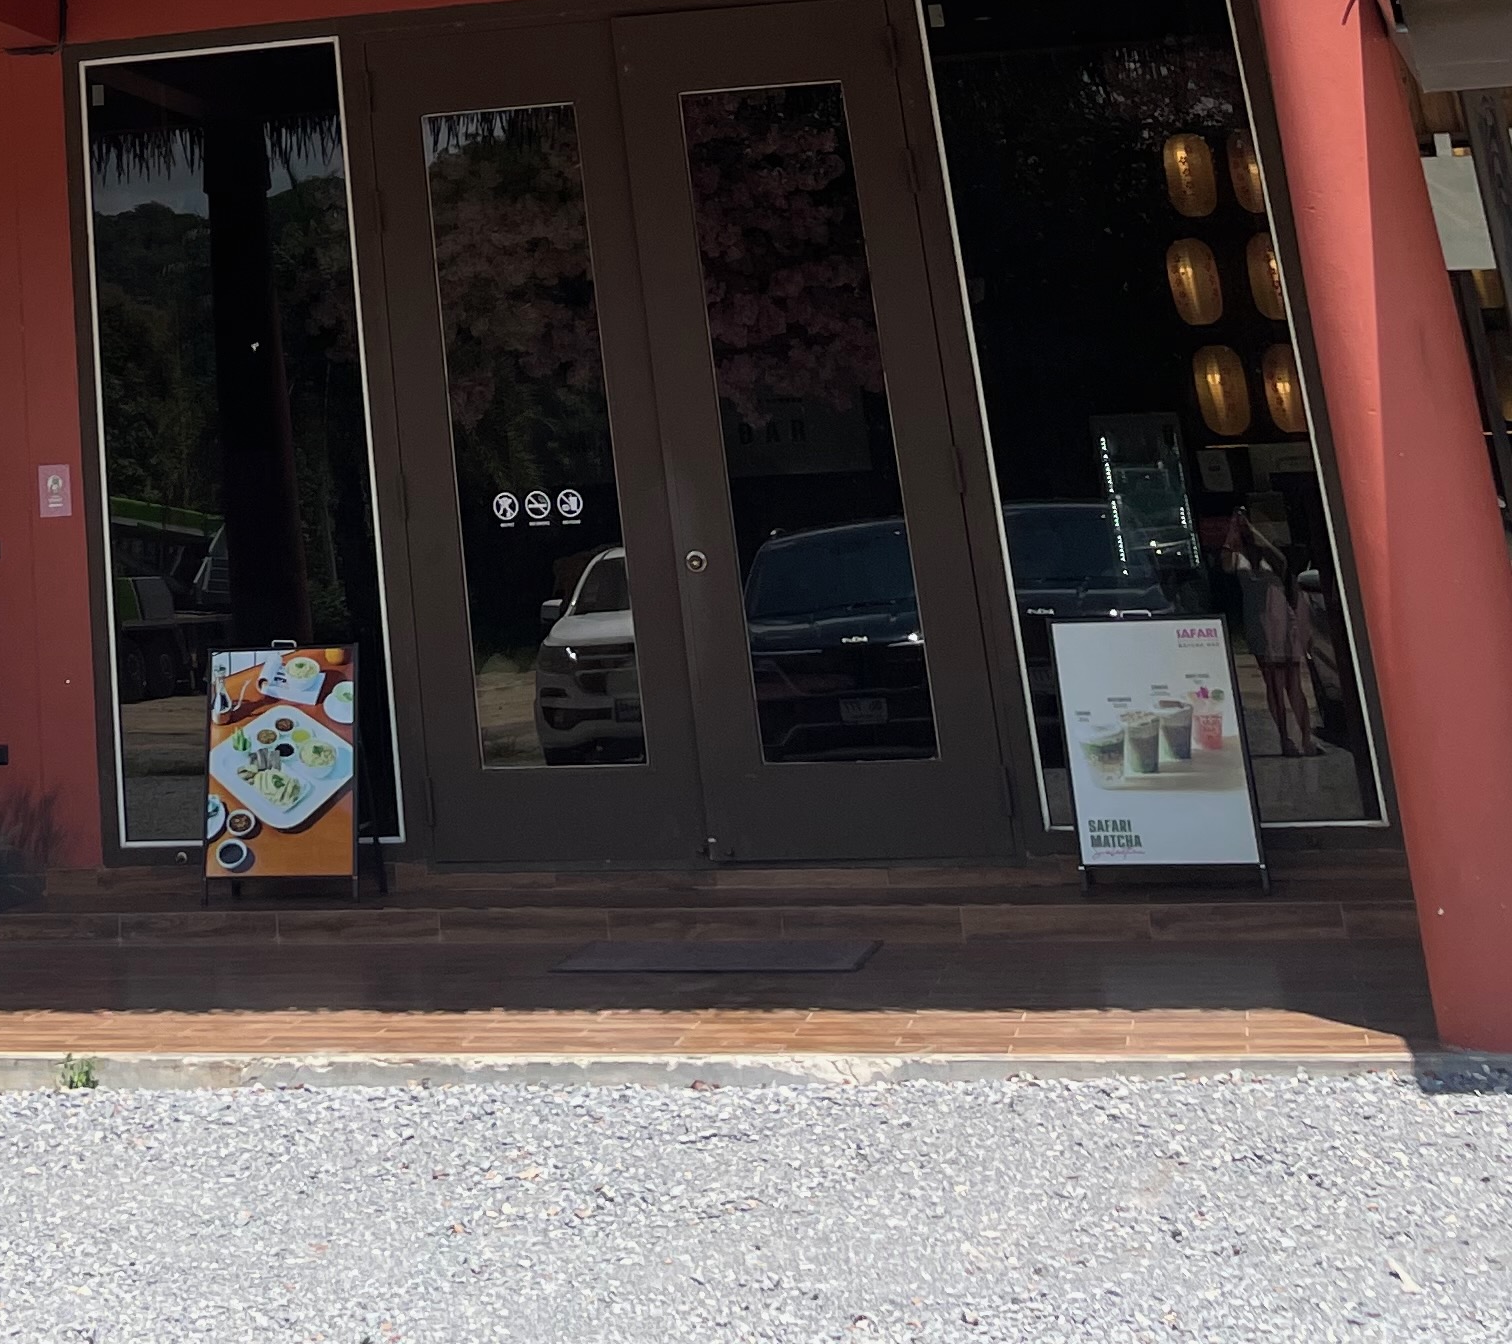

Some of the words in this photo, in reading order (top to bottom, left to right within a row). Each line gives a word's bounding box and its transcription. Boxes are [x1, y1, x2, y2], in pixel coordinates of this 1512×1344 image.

[1176, 628, 1218, 639] SAFARI
[1088, 819, 1132, 833] SAFARI
[1090, 834, 1143, 848] MATCHA
